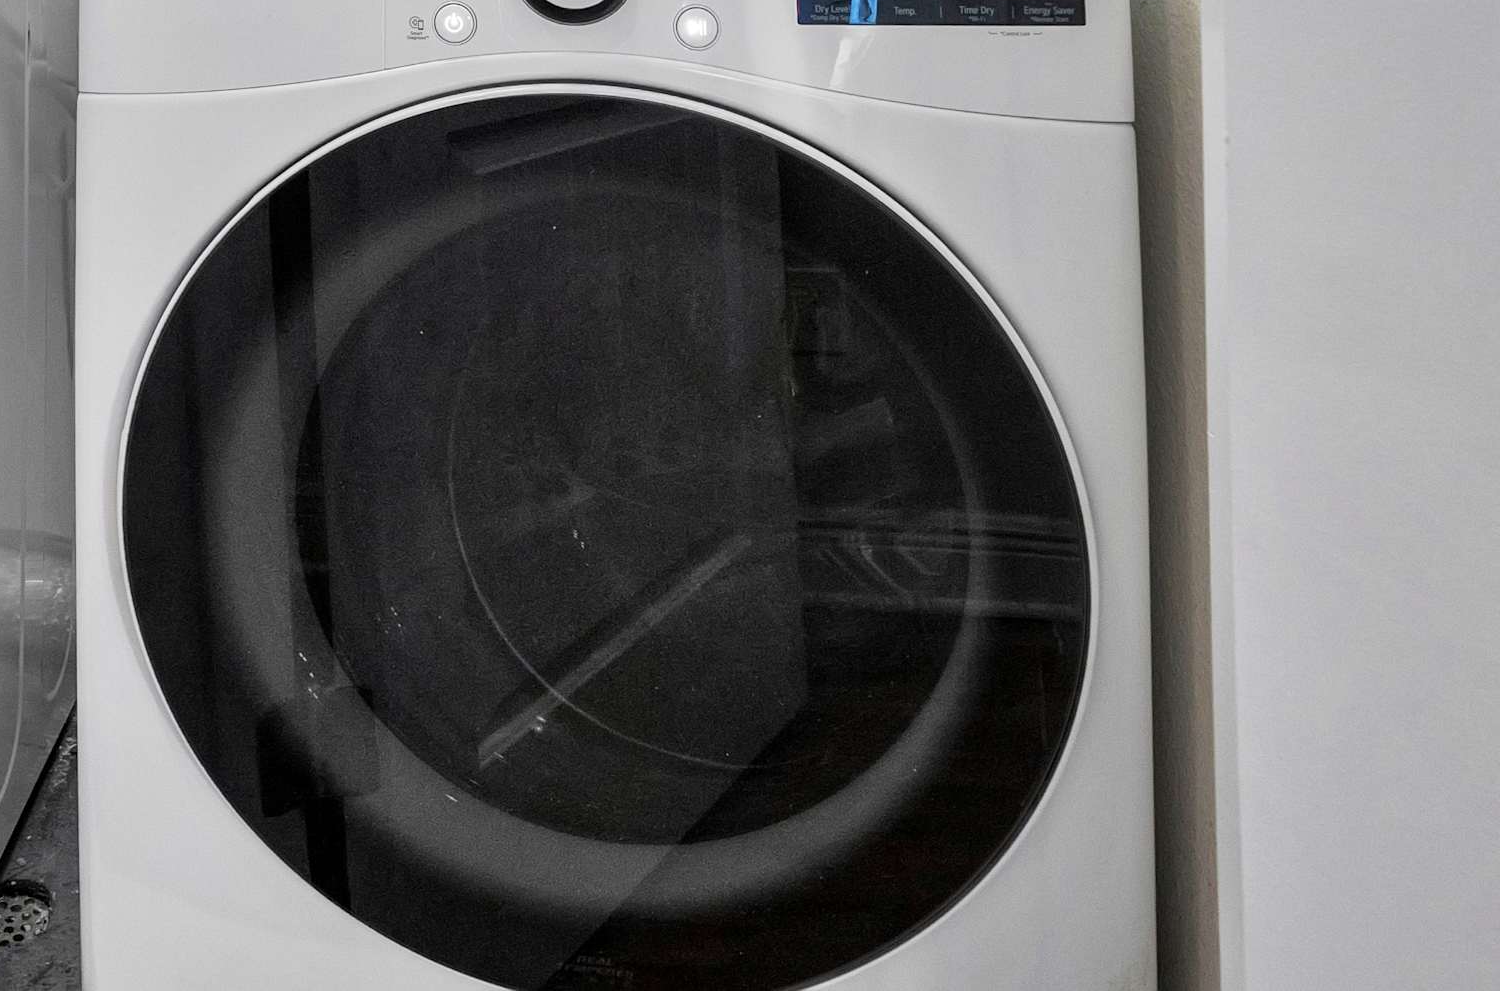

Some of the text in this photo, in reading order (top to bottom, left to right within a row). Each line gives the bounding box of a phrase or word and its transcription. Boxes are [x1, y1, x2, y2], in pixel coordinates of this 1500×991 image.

[815, 4, 850, 14] Dry Leve
[894, 7, 916, 17] Temp.
[959, 6, 995, 16] Time Dry
[1023, 6, 1075, 16] Energy Saver
